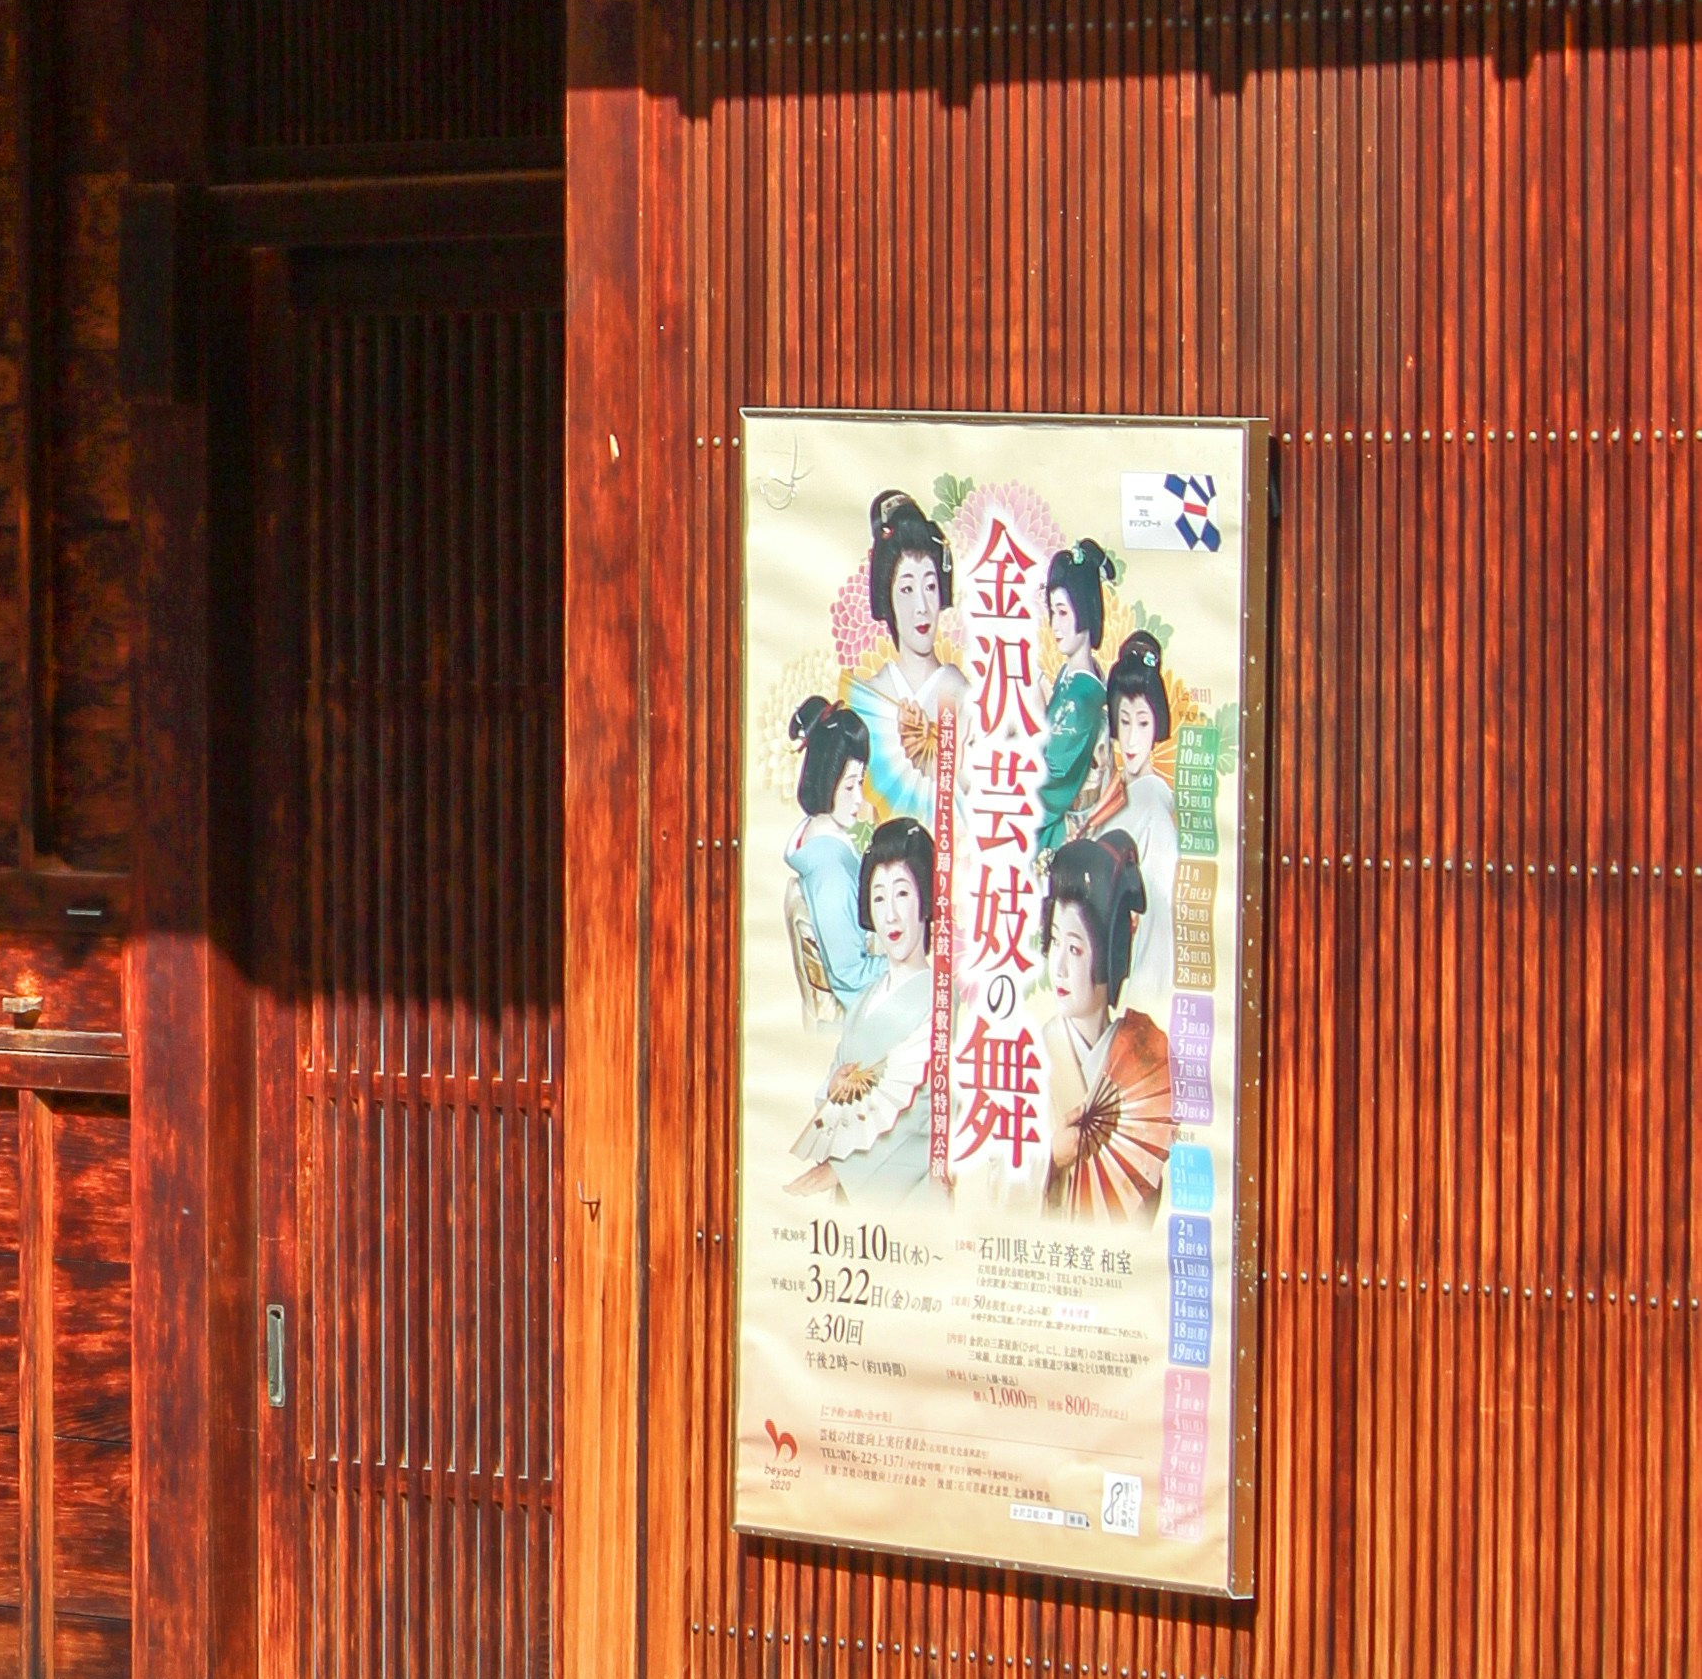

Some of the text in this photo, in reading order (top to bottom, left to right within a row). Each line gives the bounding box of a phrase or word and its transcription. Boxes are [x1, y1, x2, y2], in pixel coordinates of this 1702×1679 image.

[1182, 730, 1202, 746] 10月
[953, 517, 1042, 1168] 金沢芸妓の舞
[1179, 864, 1200, 881] 11月
[1176, 883, 1212, 901] 17日(土)
[1176, 998, 1197, 1016] 12月
[1177, 1219, 1194, 1237] 2月
[978, 1236, 1095, 1271] 石川県立音楽堂
[1100, 1248, 1133, 1275] 和室
[805, 1313, 863, 1346] 全30回
[763, 1464, 801, 1478] beyond
[770, 1479, 791, 1491] 2020
